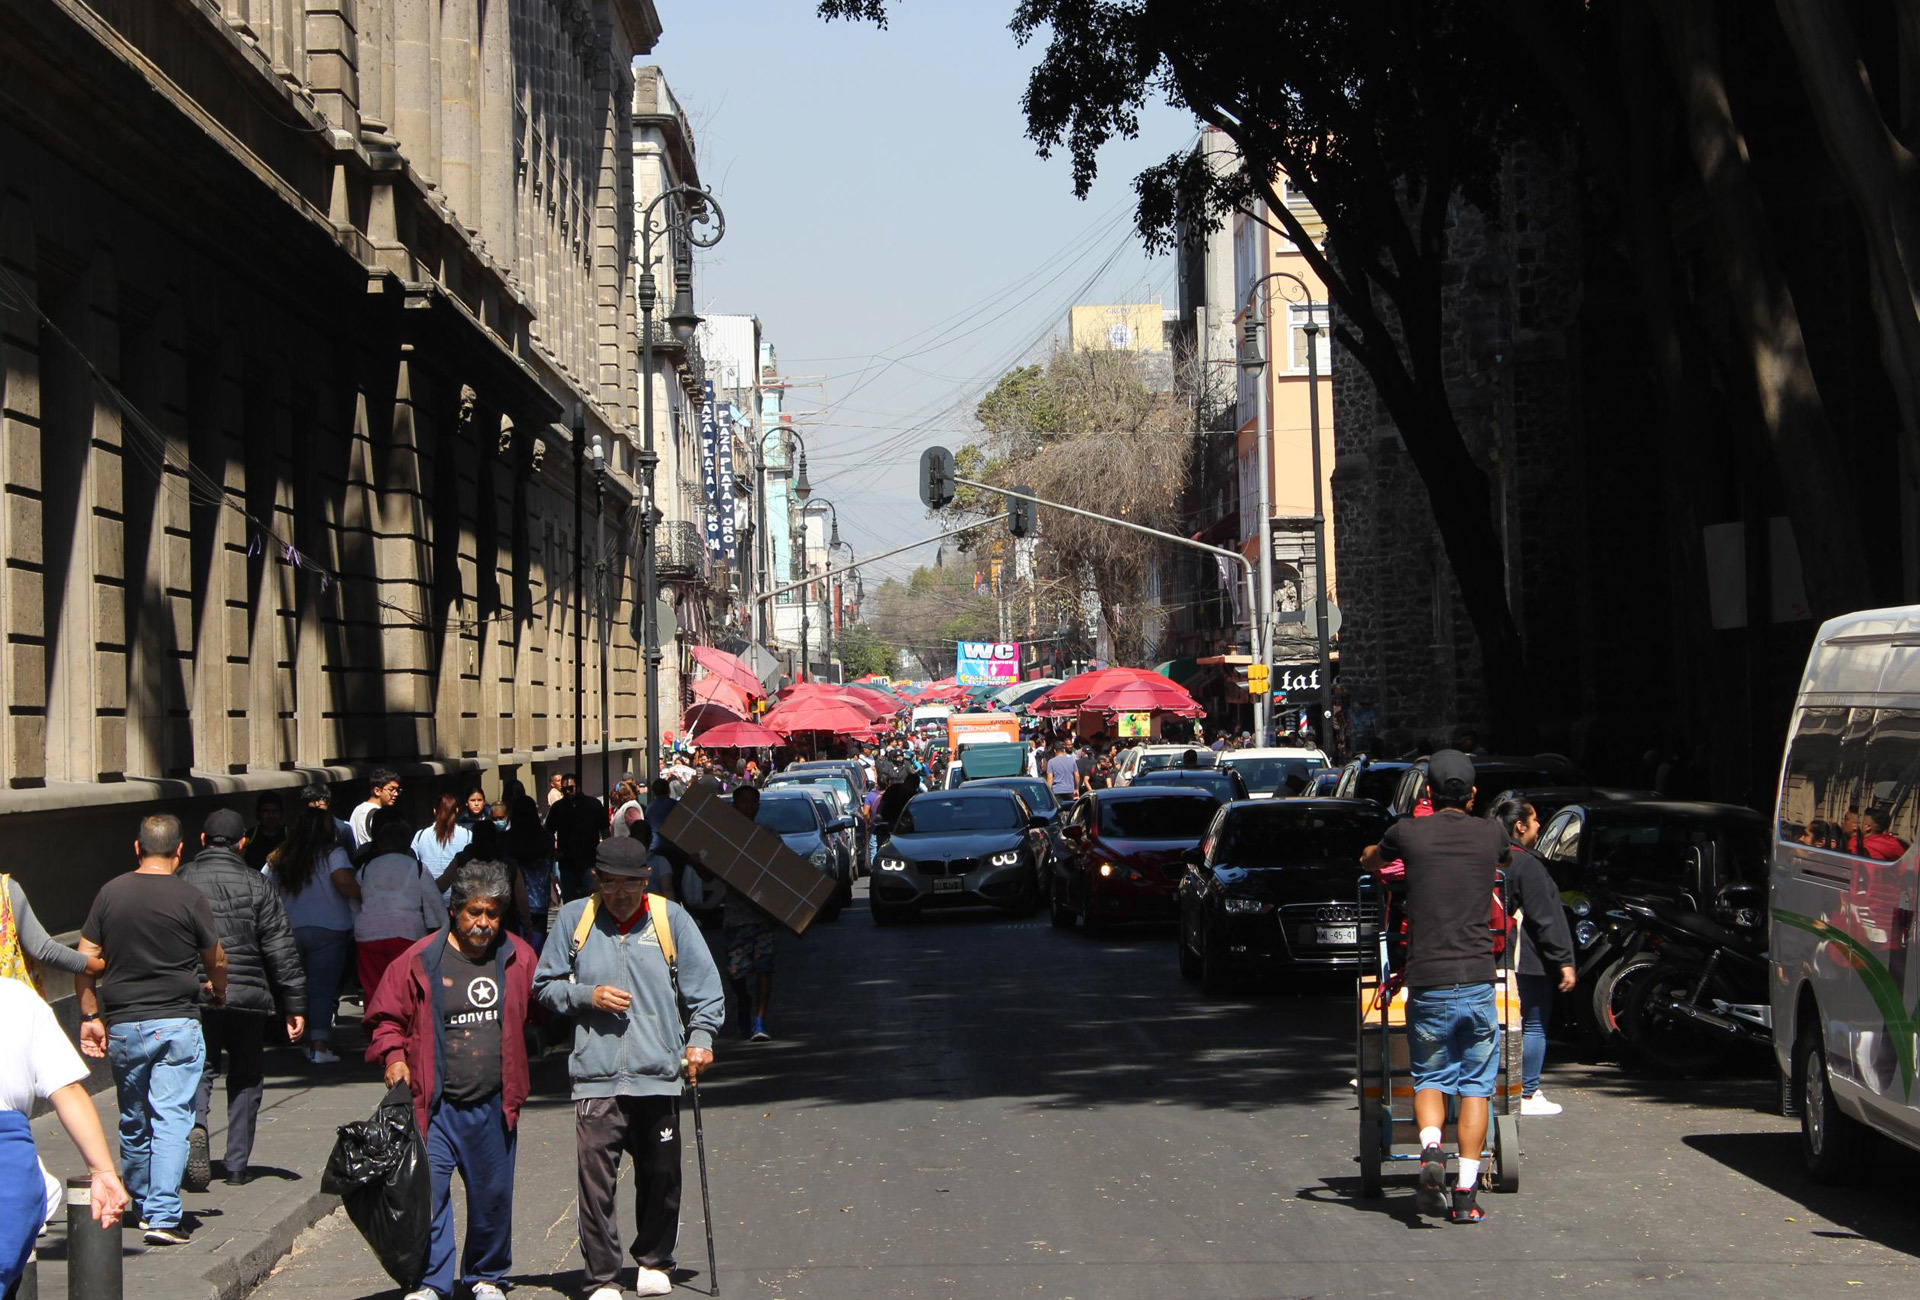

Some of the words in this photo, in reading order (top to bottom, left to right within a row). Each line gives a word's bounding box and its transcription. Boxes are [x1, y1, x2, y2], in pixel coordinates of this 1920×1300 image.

[718, 410, 730, 452] PLAZA
[703, 438, 714, 485] PLATA
[720, 457, 733, 500] PLATA
[707, 490, 715, 499] Y
[722, 504, 732, 513] Y
[722, 517, 734, 543] ORO
[963, 643, 1014, 660] WC
[1281, 668, 1321, 691] tat
